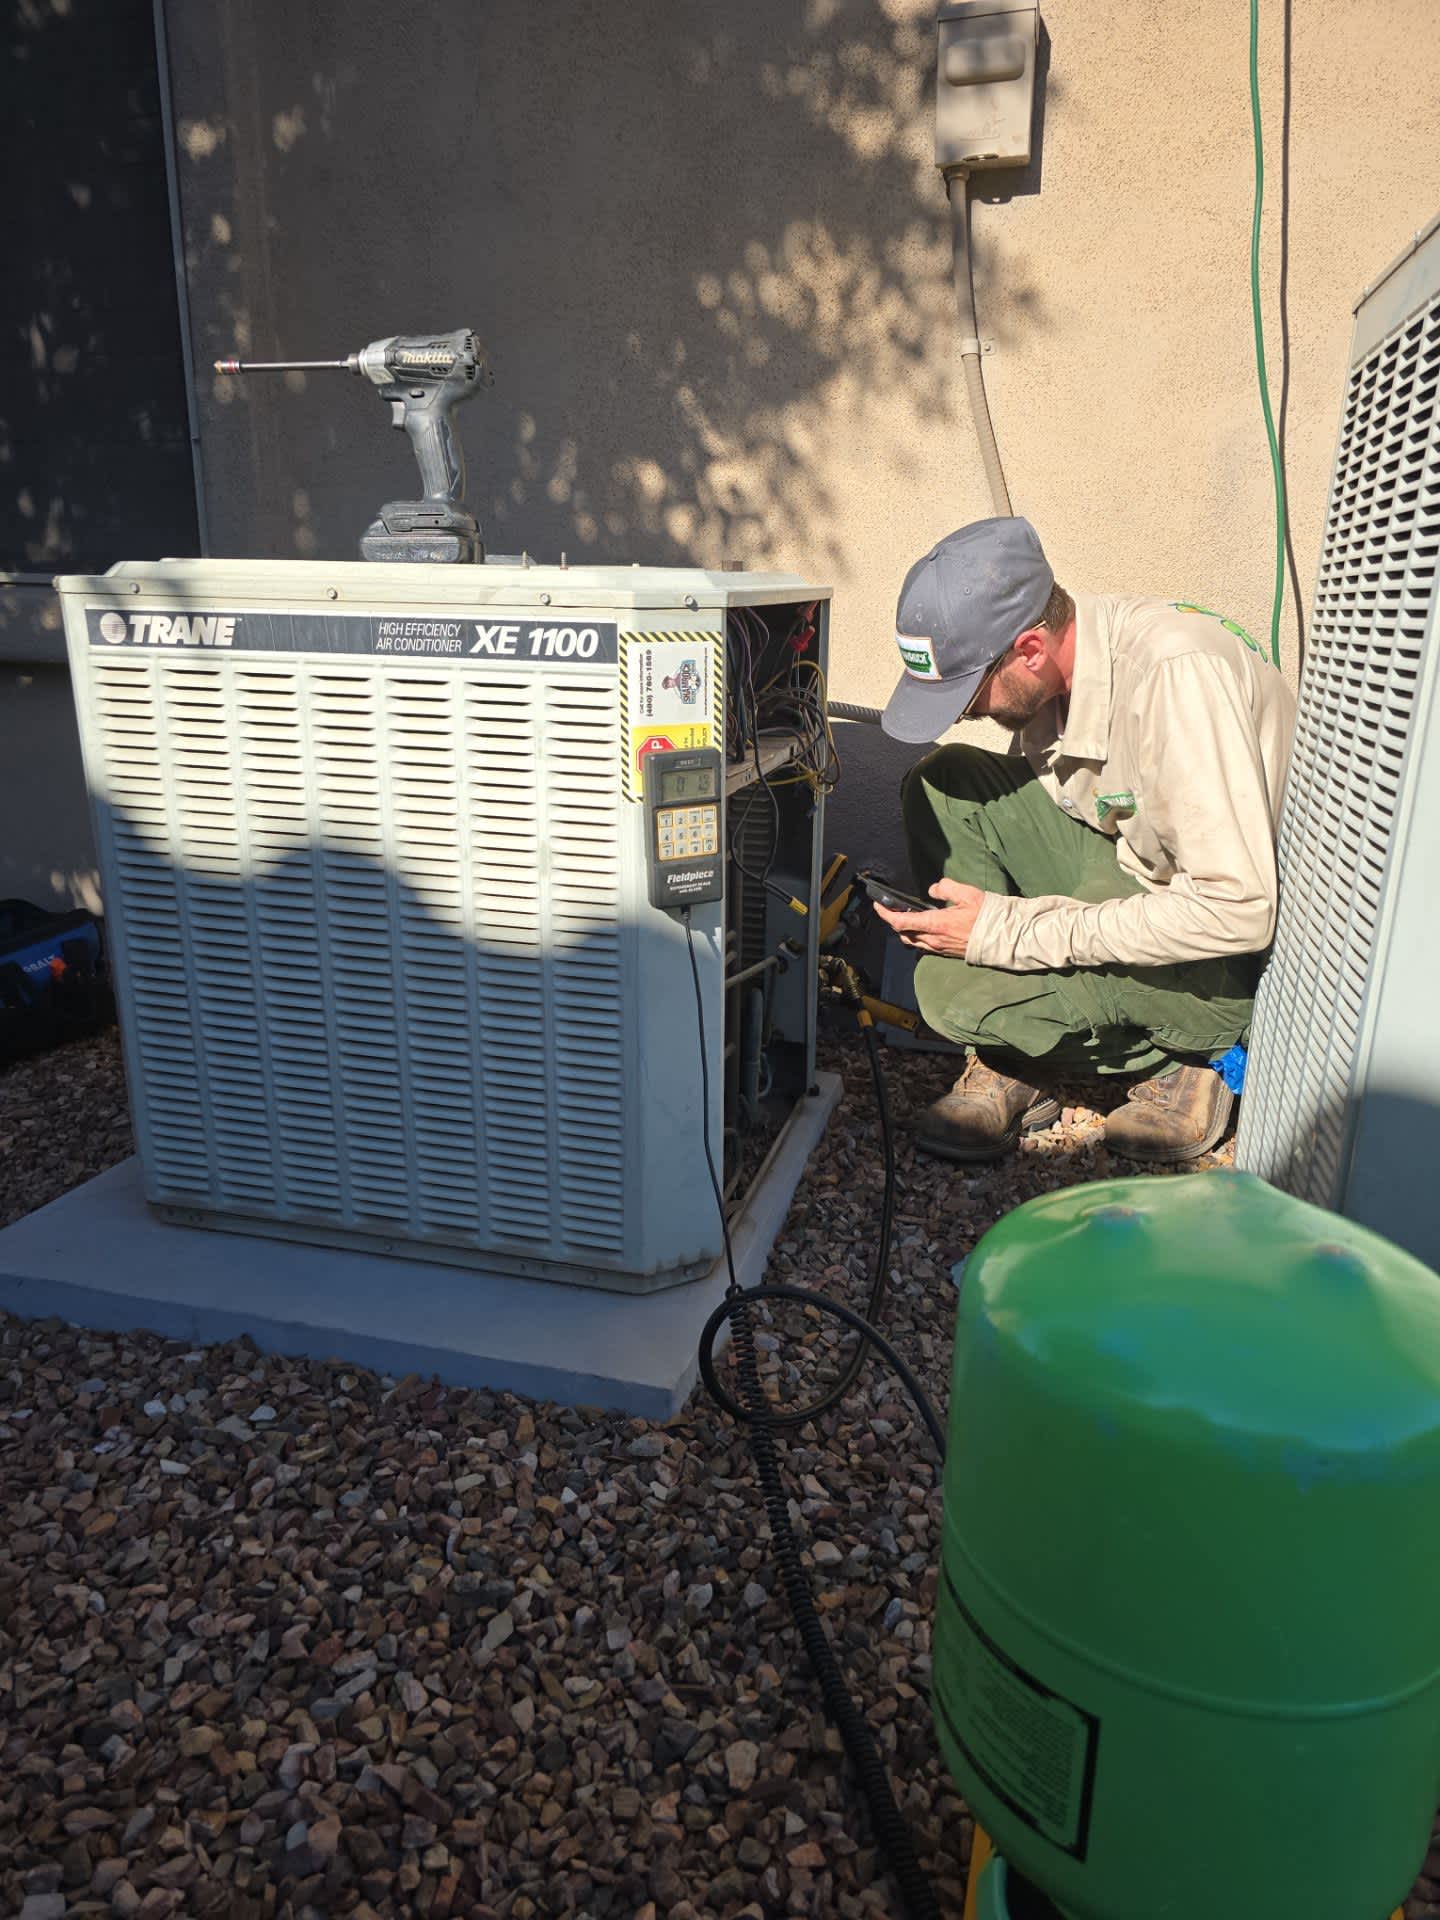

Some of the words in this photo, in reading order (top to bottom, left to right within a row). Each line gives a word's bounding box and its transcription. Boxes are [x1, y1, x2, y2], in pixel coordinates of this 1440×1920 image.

[129, 614, 236, 647] TRANE
[379, 621, 403, 636] HIGH
[404, 622, 461, 638] EFFICIENCY
[376, 636, 394, 651] AIR
[395, 636, 462, 653] CONDITIONER
[470, 625, 520, 656] XE
[528, 626, 599, 658] 1100
[667, 869, 714, 884] Fieldpiece
